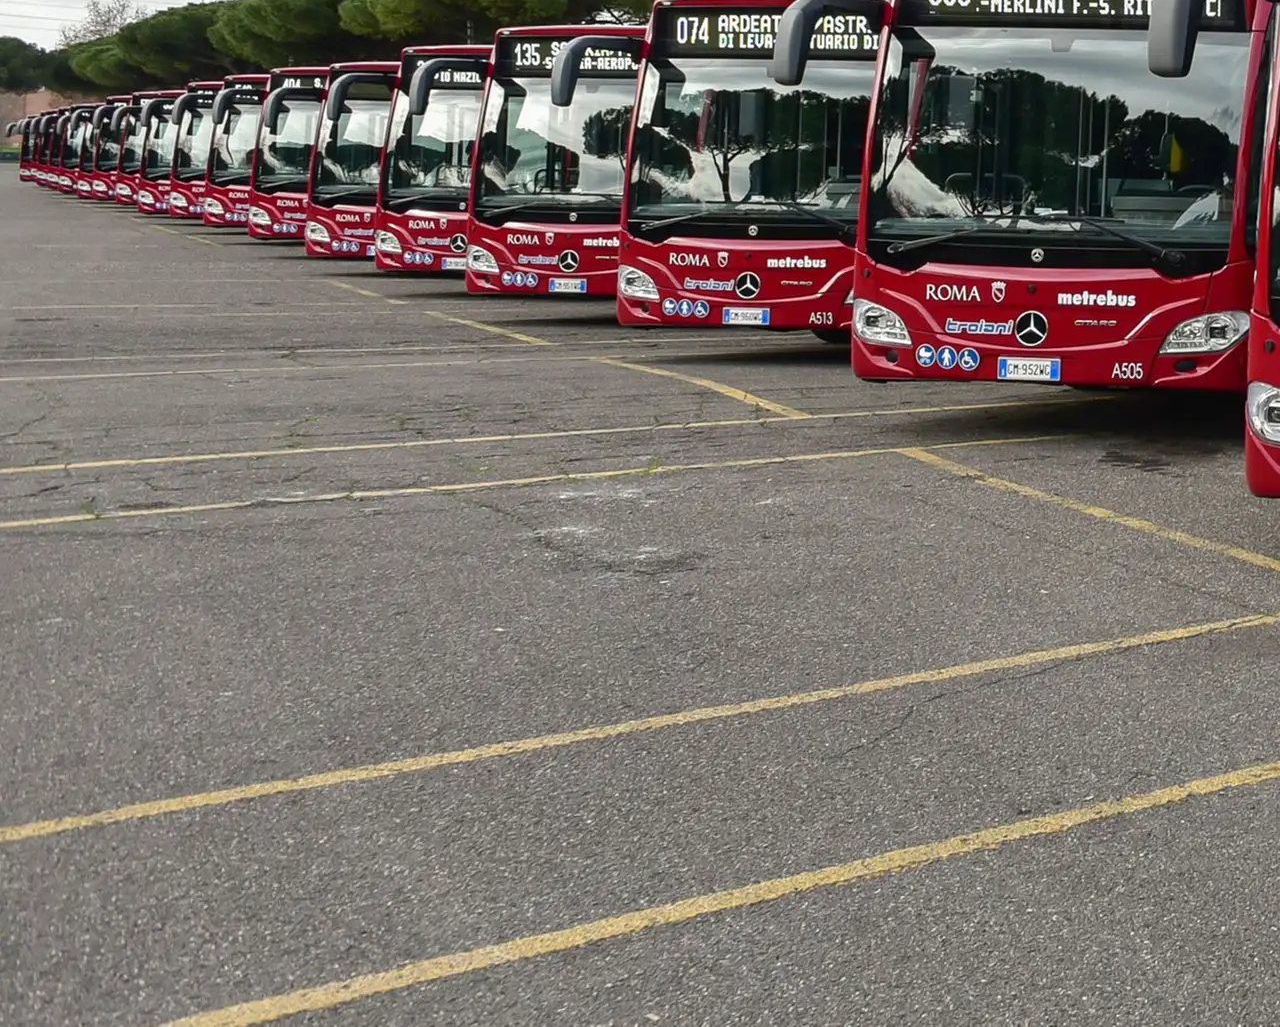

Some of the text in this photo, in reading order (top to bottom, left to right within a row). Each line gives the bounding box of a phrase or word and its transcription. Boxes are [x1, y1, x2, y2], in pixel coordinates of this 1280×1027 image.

[677, 17, 709, 44] 074
[719, 34, 734, 49] DI
[515, 43, 540, 66] 135
[276, 199, 300, 207] ROMA
[335, 214, 361, 223] ROMA
[408, 220, 436, 230] ROMA
[507, 234, 540, 245] ROMA
[669, 252, 710, 267] ROMA
[767, 255, 827, 268] metrebus
[926, 283, 981, 302] ROMA
[1057, 290, 1136, 307] metrebus
[808, 311, 833, 325] A513
[945, 318, 1014, 335] troiani
[1111, 362, 1143, 380] A505
